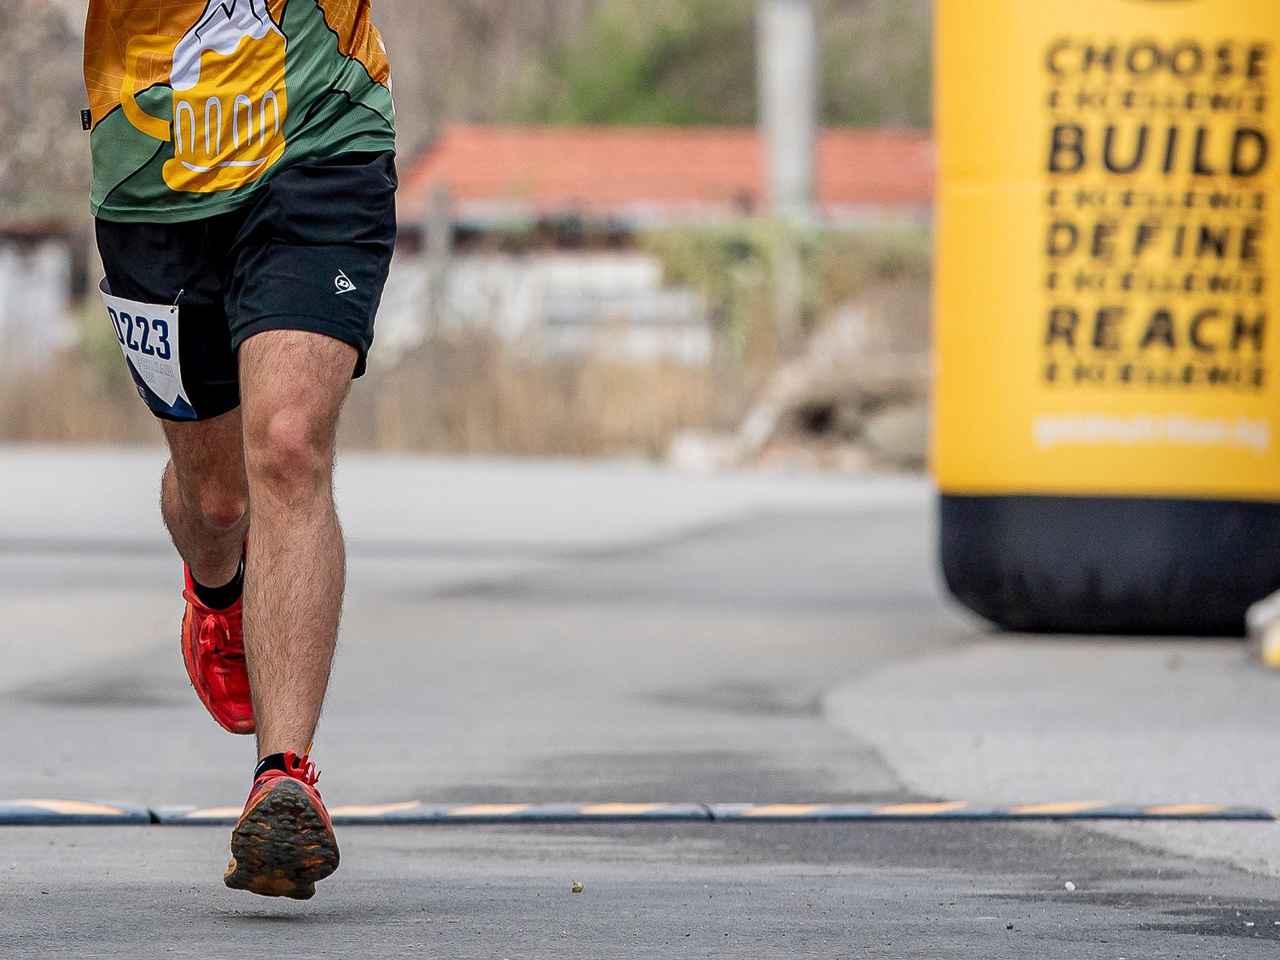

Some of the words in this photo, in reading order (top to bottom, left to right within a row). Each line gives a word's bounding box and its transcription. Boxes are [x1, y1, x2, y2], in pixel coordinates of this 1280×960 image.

[1046, 39, 1267, 80] CHOOSE
[1047, 123, 1269, 178] BUILD
[1046, 221, 1264, 260] DEFINE
[1045, 306, 1267, 352] REACH
